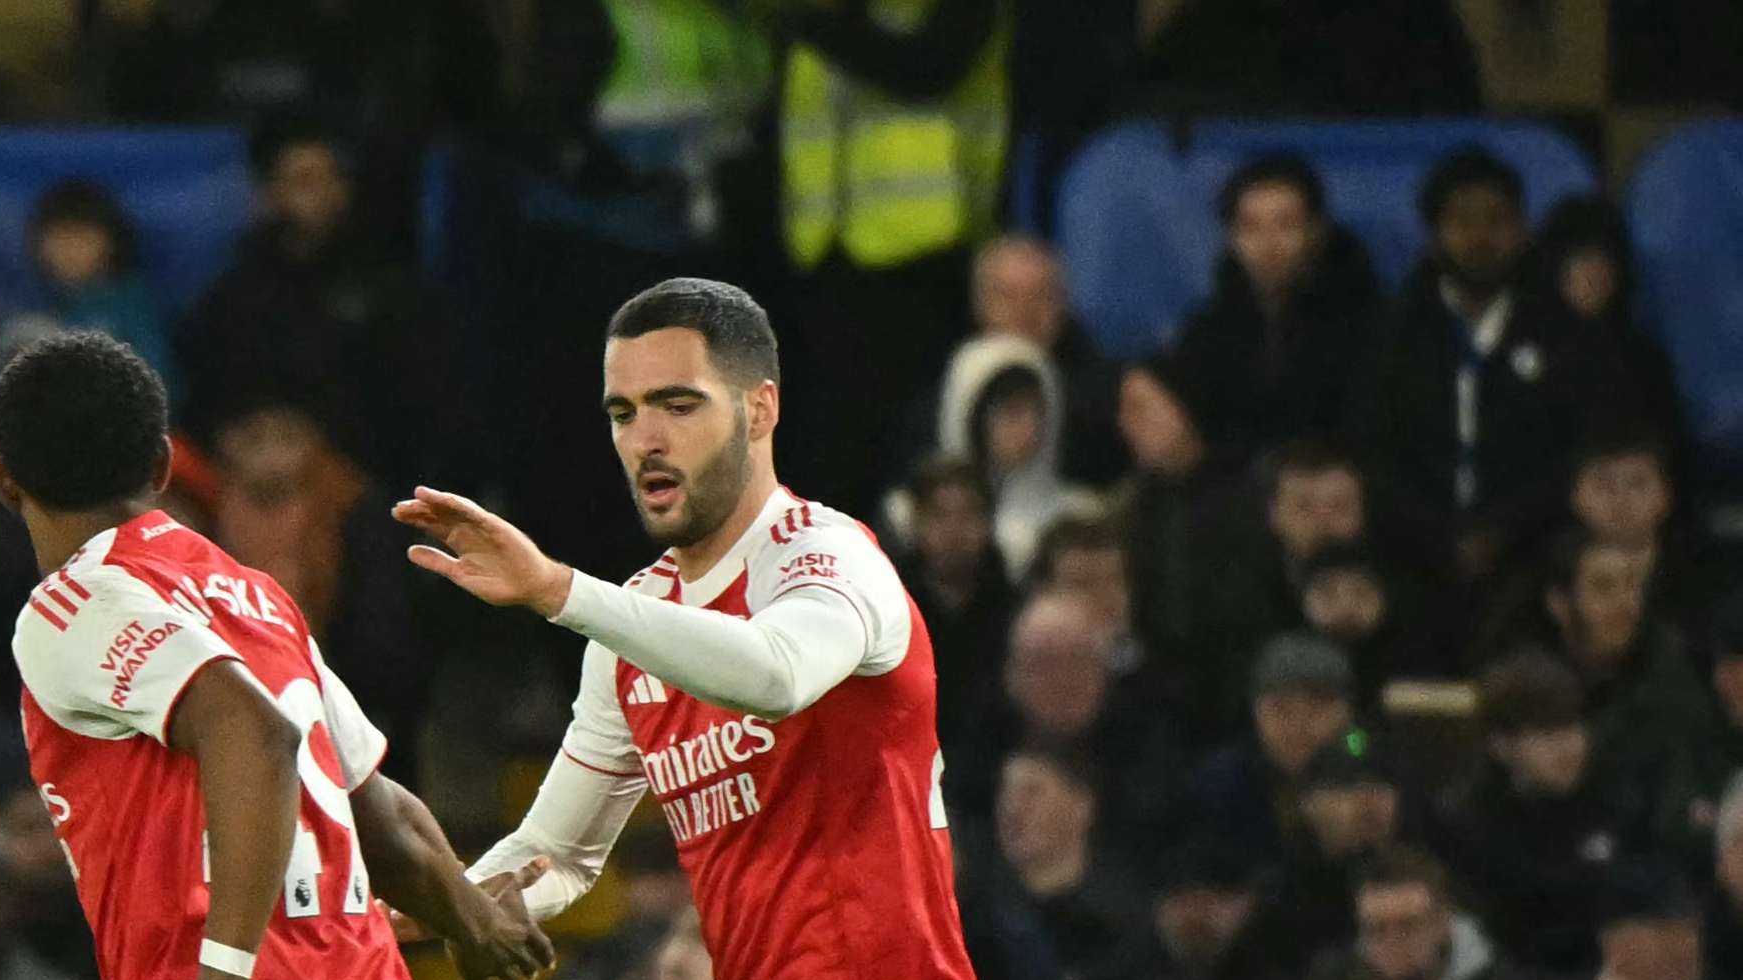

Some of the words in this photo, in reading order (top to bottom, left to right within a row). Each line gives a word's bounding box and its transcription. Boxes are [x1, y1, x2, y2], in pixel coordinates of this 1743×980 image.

[99, 620, 146, 671] VISIT
[111, 622, 184, 708] RWANDA
[641, 713, 776, 796] mirates
[689, 772, 761, 836] BETTER
